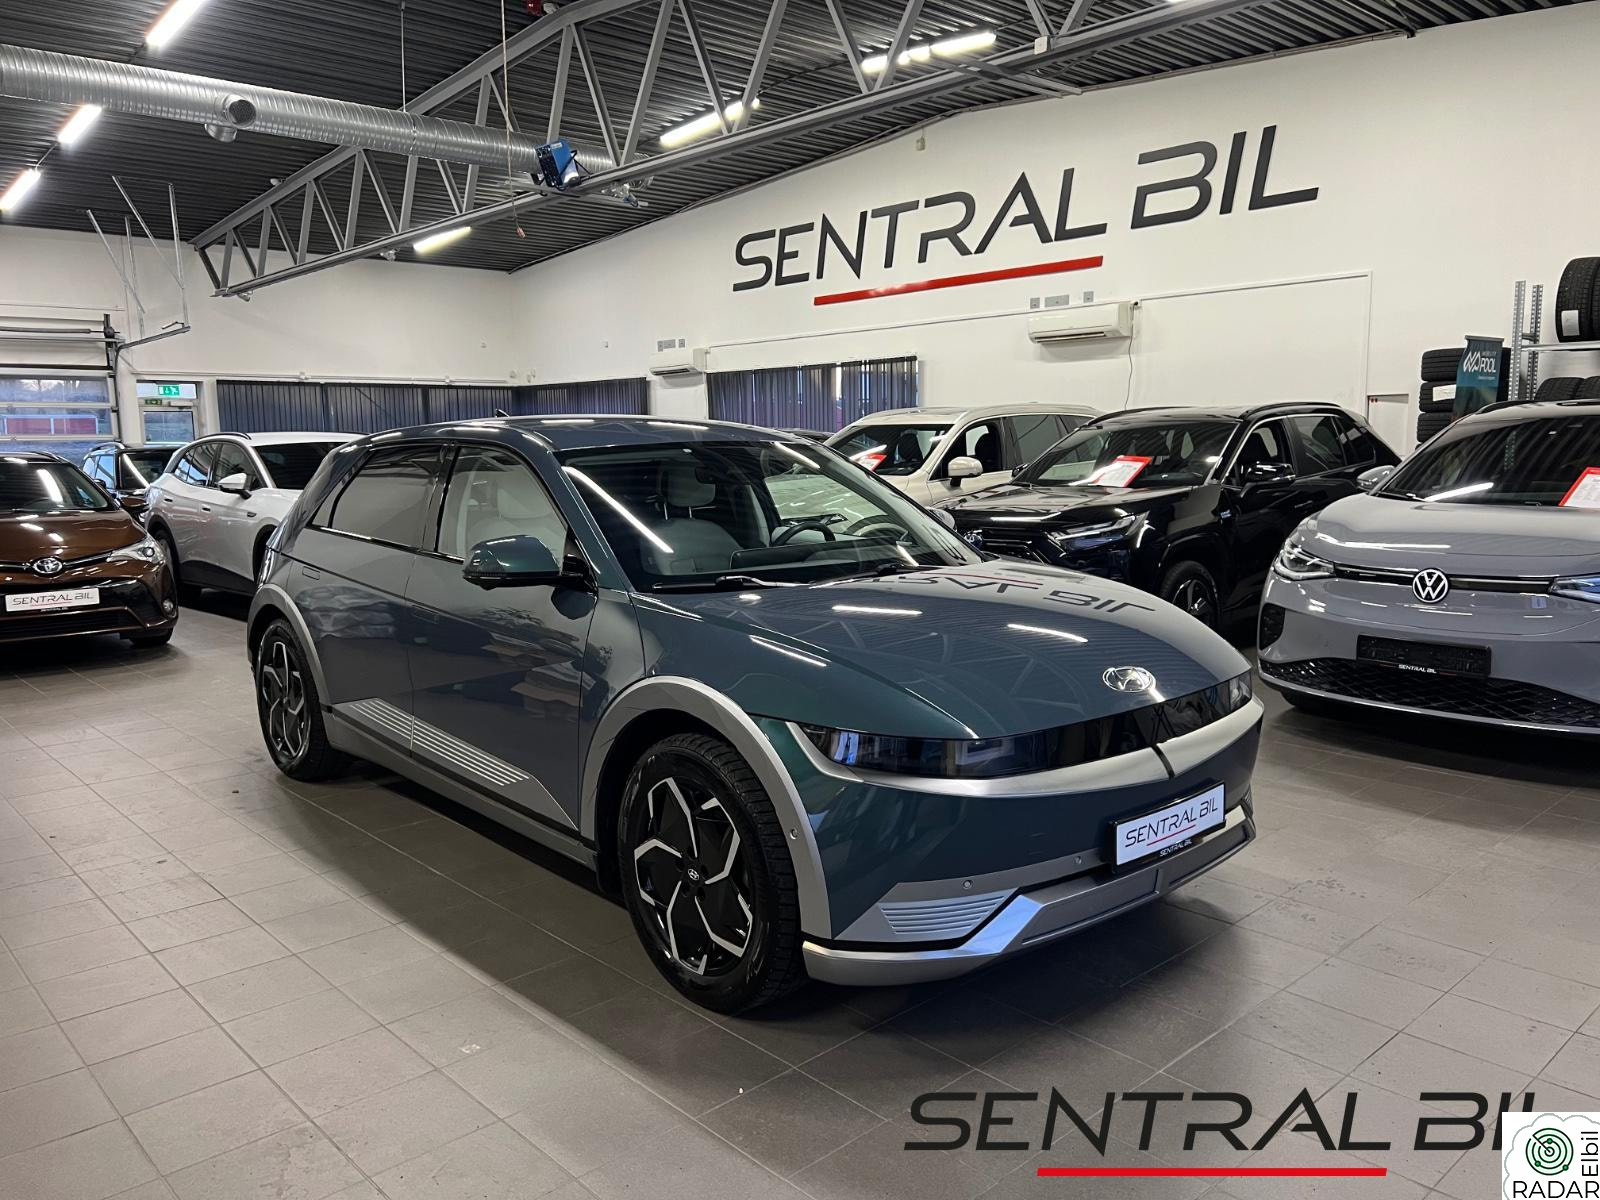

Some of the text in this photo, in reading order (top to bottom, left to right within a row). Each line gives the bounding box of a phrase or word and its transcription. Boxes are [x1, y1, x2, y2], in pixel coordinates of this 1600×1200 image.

[733, 125, 1320, 292] SENTRAL BIL
[12, 592, 94, 605] SENTRAL BIL
[1125, 797, 1218, 848] SENTRAL BIL
[1159, 842, 1184, 857] SENTRAL
